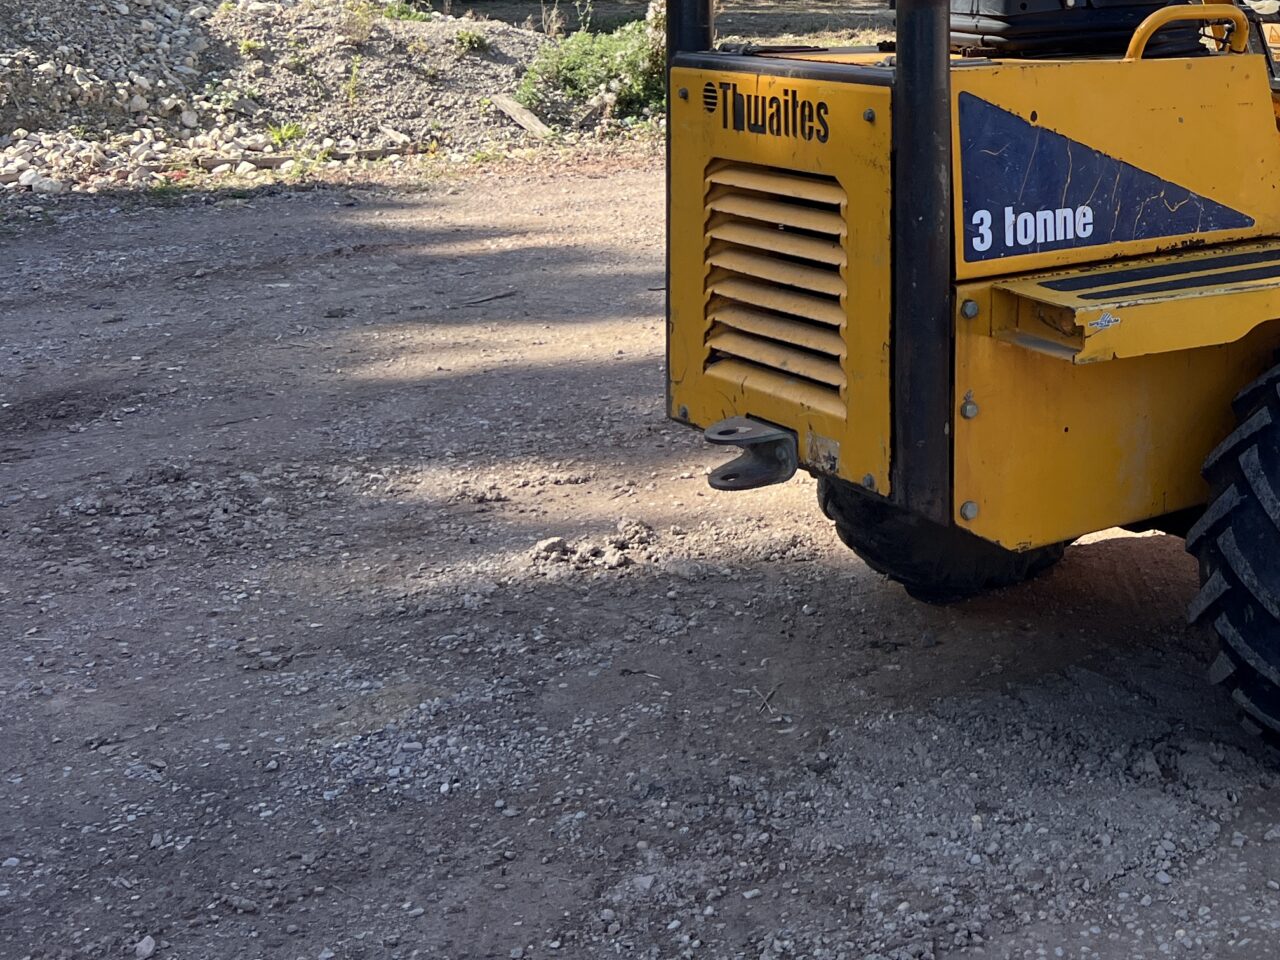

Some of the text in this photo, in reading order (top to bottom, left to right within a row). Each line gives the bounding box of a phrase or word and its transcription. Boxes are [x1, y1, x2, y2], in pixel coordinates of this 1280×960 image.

[719, 82, 829, 143] Thwaites
[972, 205, 1094, 252] 3 tonne
